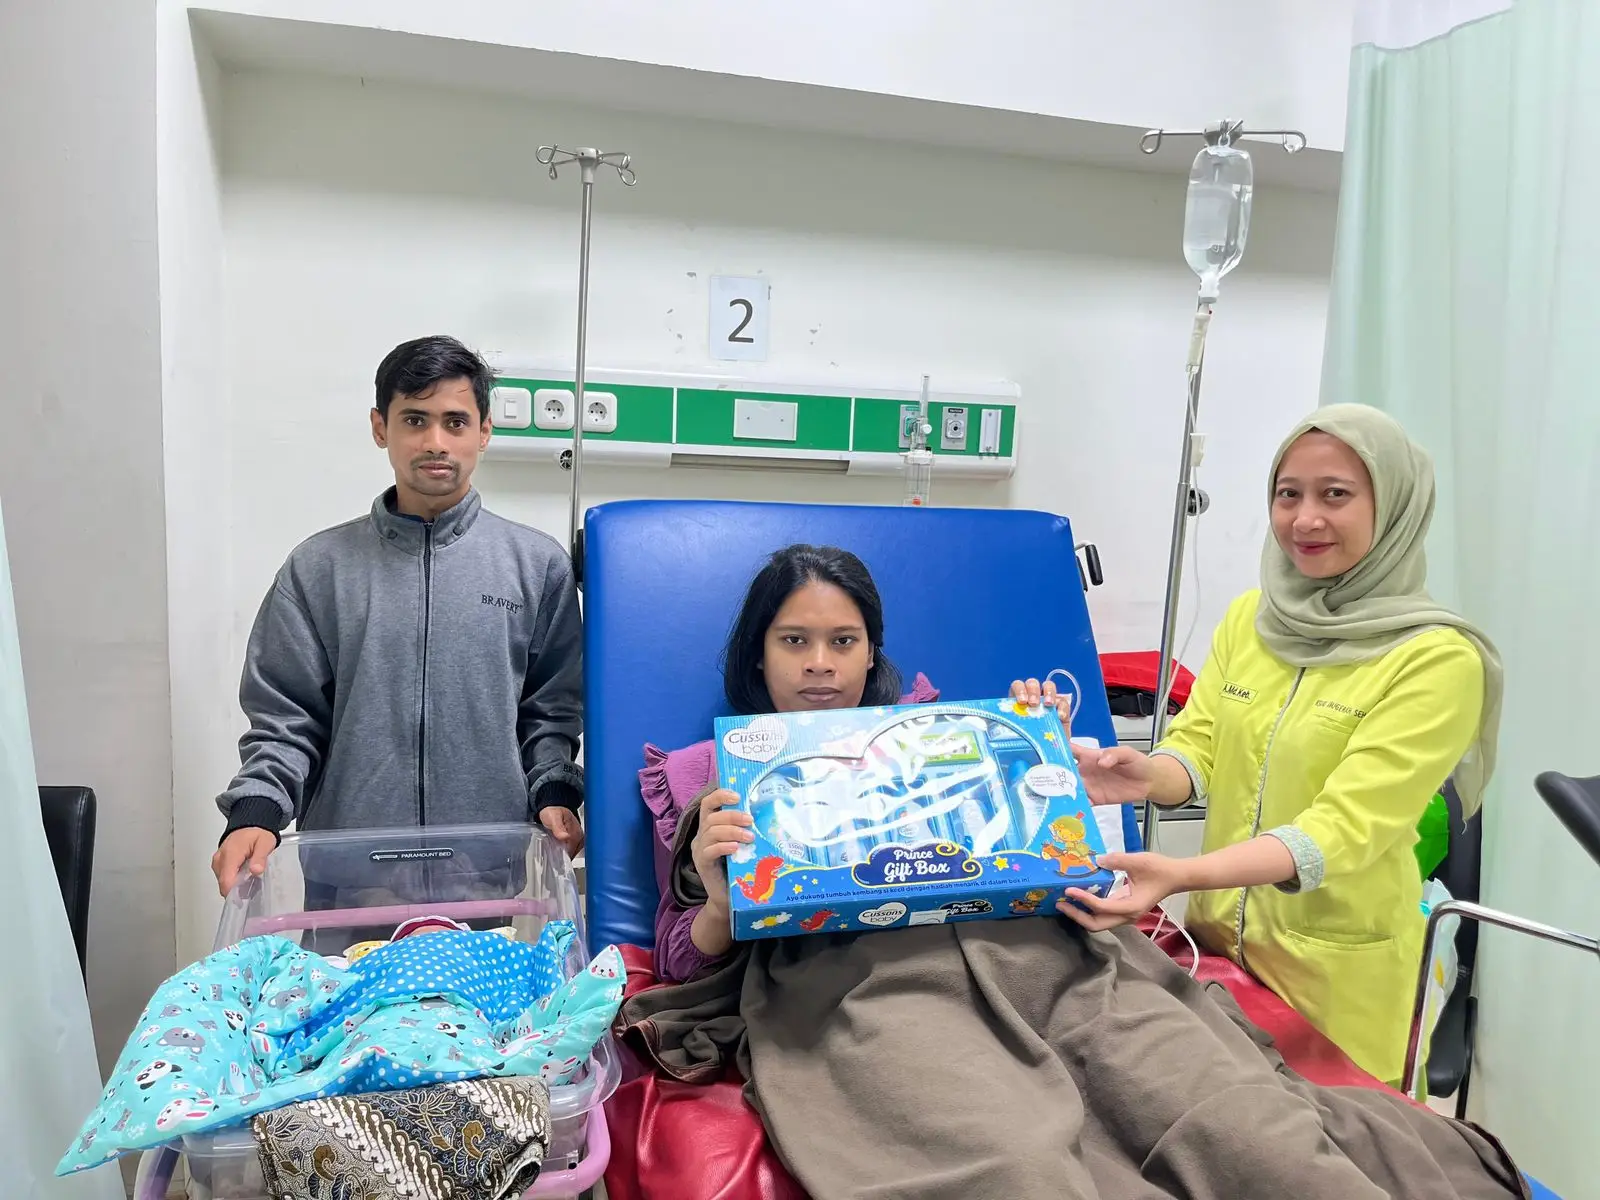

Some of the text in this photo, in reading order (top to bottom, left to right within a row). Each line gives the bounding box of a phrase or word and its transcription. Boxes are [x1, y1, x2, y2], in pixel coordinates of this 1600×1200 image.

[728, 298, 754, 343] 2
[893, 849, 934, 861] Prince
[884, 860, 951, 883] Gift Box
[800, 893, 825, 901] dukung
[825, 891, 851, 899] tumbuh
[852, 887, 882, 897] kembang
[906, 884, 930, 893] dengan
[931, 882, 953, 890] hadiah
[862, 909, 903, 918] Cussons
